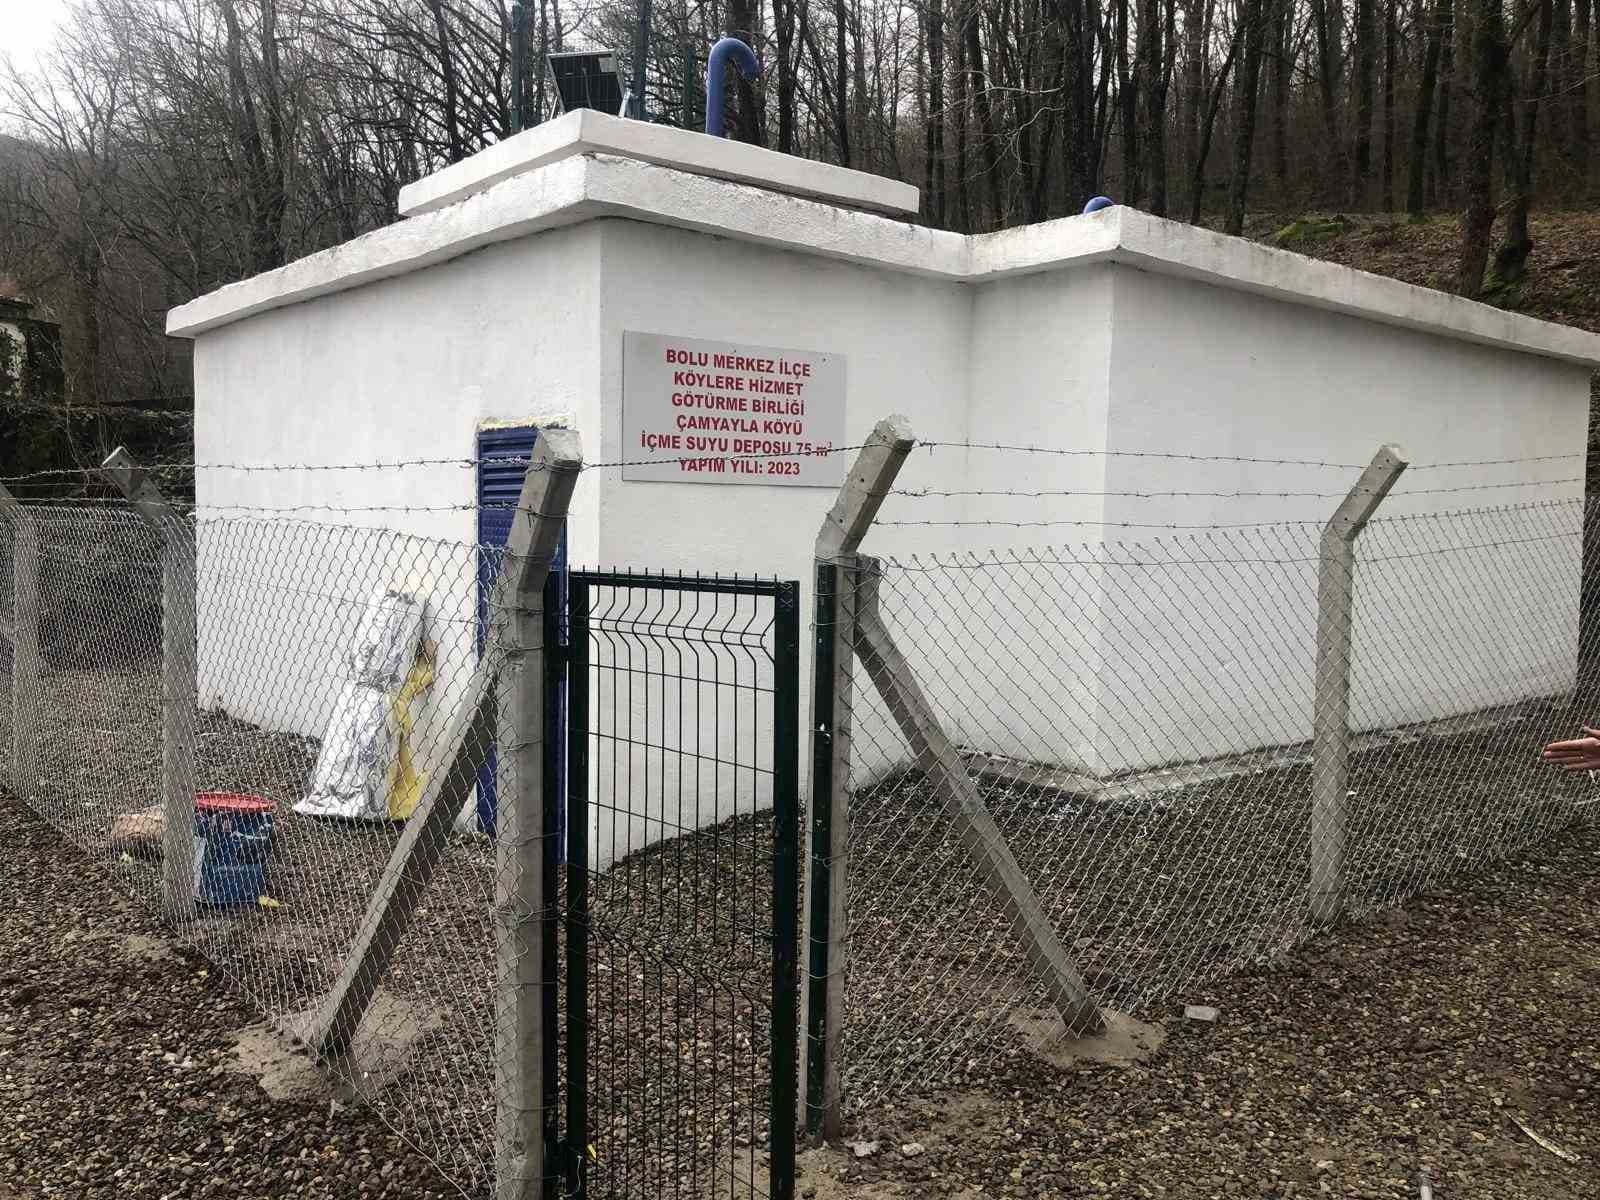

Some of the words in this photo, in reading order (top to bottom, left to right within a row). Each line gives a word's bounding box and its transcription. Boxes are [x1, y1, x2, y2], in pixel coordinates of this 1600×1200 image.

[666, 349, 709, 367] BOLU
[713, 354, 774, 373] MERKEZ
[779, 358, 811, 379] İLÇE
[674, 371, 744, 391] KÖYLERE
[749, 376, 804, 396] HİZMET
[672, 391, 747, 411] GÖTÜRME
[752, 397, 805, 416] BİRLİĞİ
[677, 414, 758, 433] ÇAMYAYLA
[764, 417, 803, 435] KÖYÜ
[641, 430, 681, 452] İÇME
[686, 436, 729, 452] SUYU
[734, 439, 791, 454] DEPOSU
[796, 442, 812, 456] 75
[680, 457, 725, 473] YAPIM
[730, 459, 763, 474] YILI:
[768, 461, 800, 475] 2023
